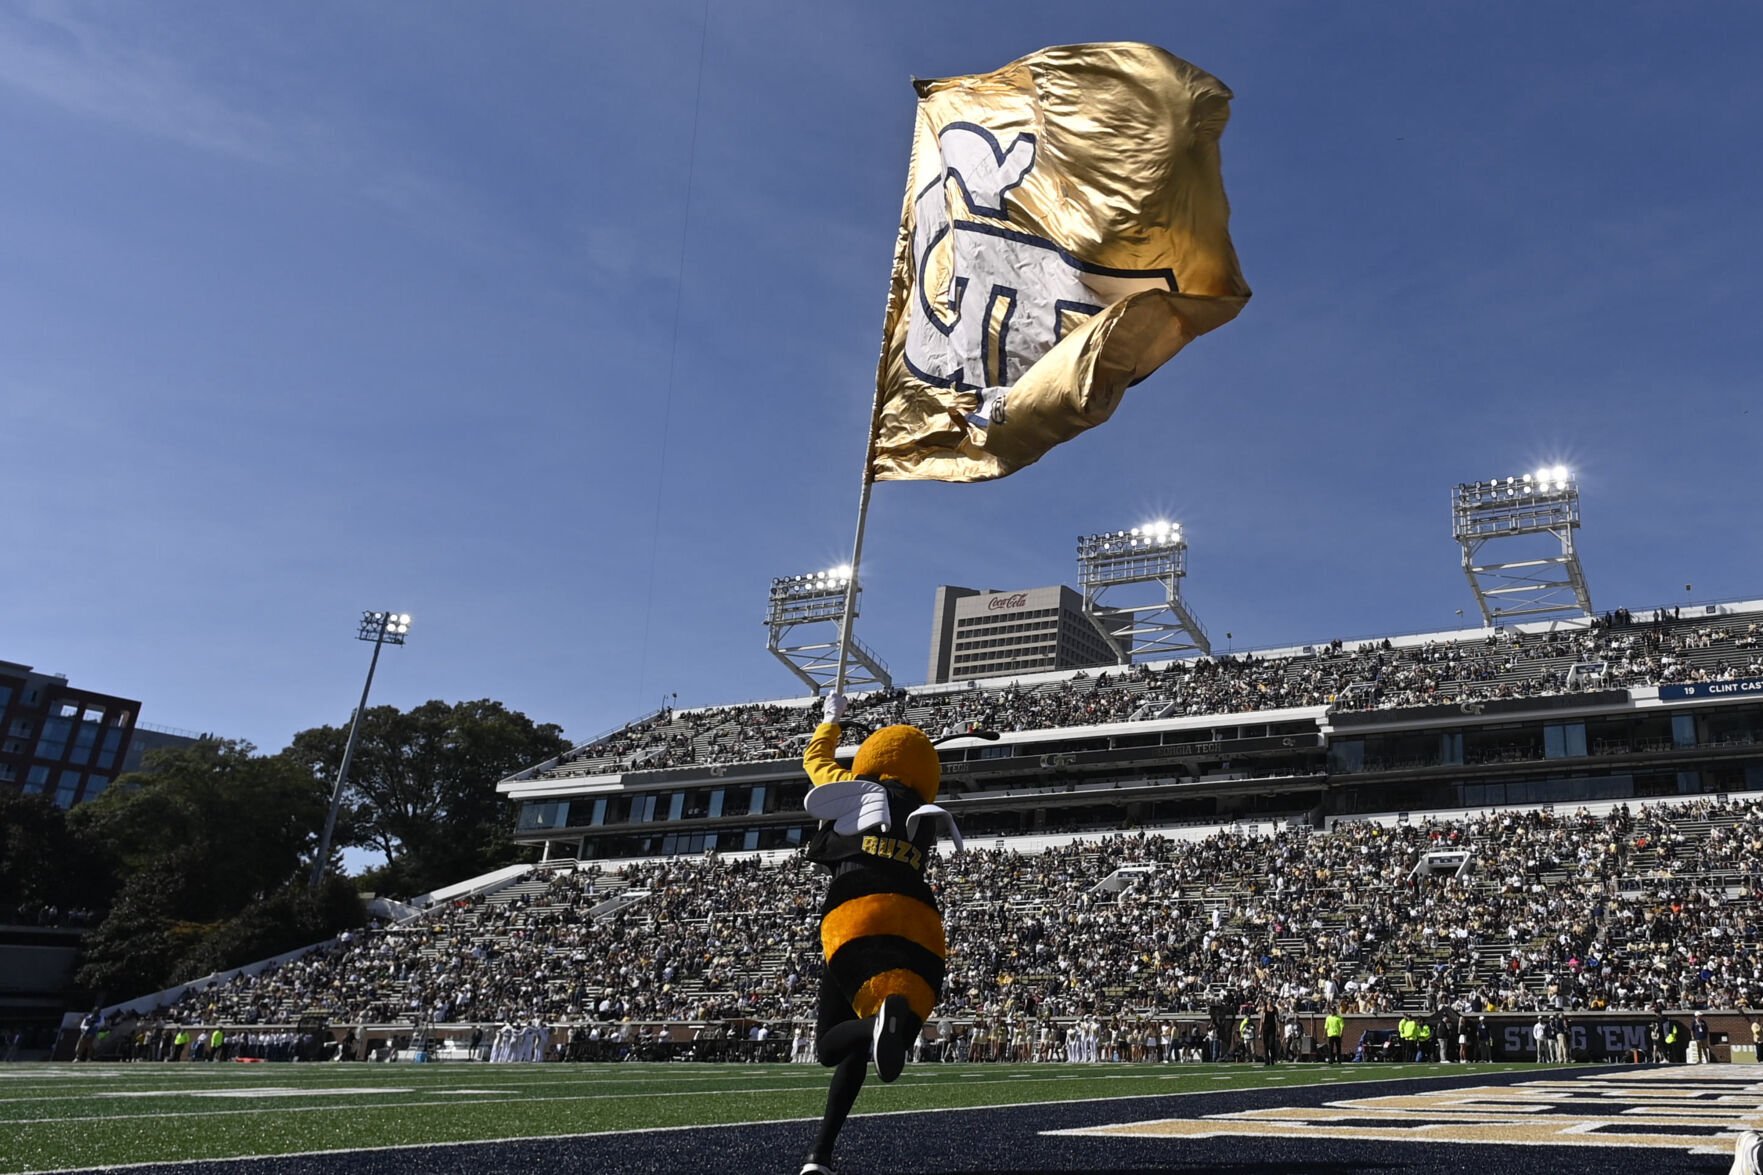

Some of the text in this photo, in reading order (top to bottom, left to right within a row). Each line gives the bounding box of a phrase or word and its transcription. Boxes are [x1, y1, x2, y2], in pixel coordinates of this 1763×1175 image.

[988, 593, 1028, 611] Coca-Cola
[1684, 687, 1695, 695] 19
[1708, 683, 1738, 693] CLINT
[1195, 743, 1222, 754] TECH
[946, 763, 969, 774] TECH
[861, 835, 922, 871] BUZZ
[1503, 1025, 1587, 1052] STG
